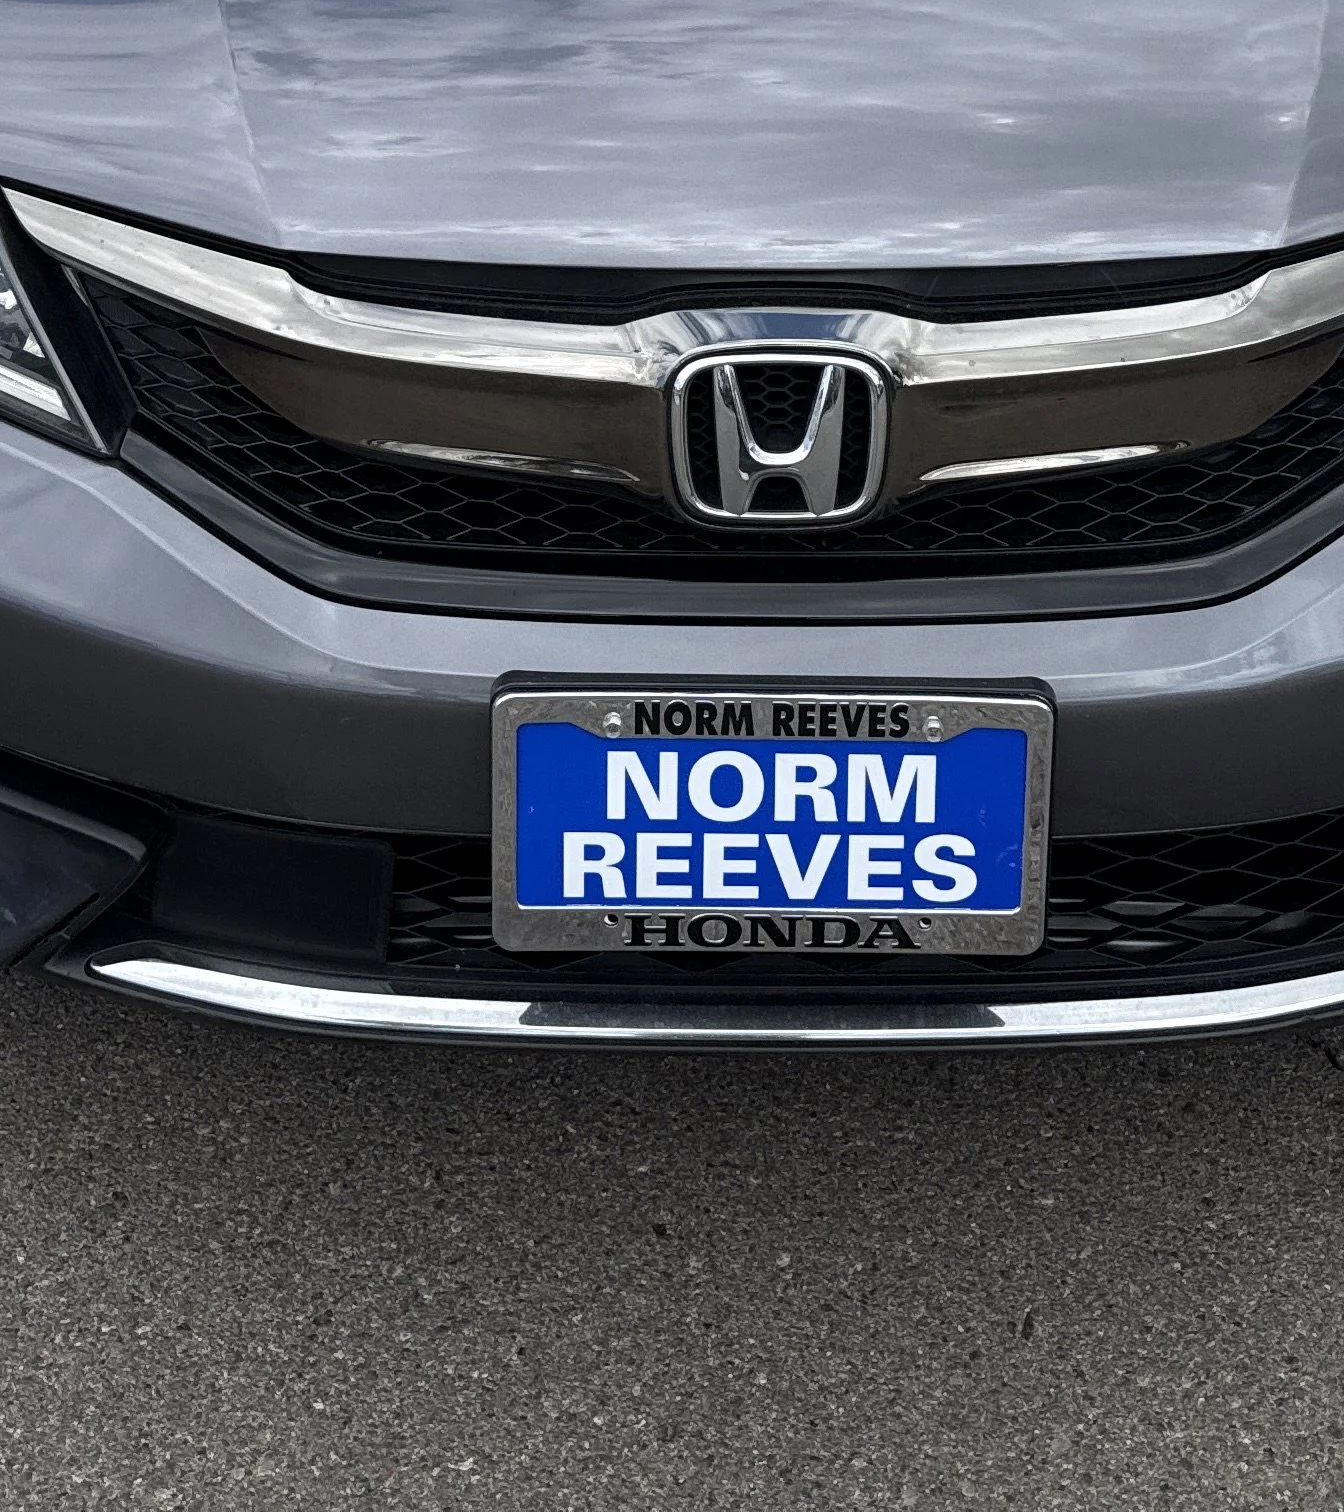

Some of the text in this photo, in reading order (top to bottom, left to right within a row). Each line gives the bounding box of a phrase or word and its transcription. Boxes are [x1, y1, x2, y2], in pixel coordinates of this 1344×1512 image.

[633, 700, 911, 738] NORM REEVES
[606, 750, 937, 823] NORM
[563, 831, 978, 903] REEVES
[623, 912, 922, 949] HONDA
